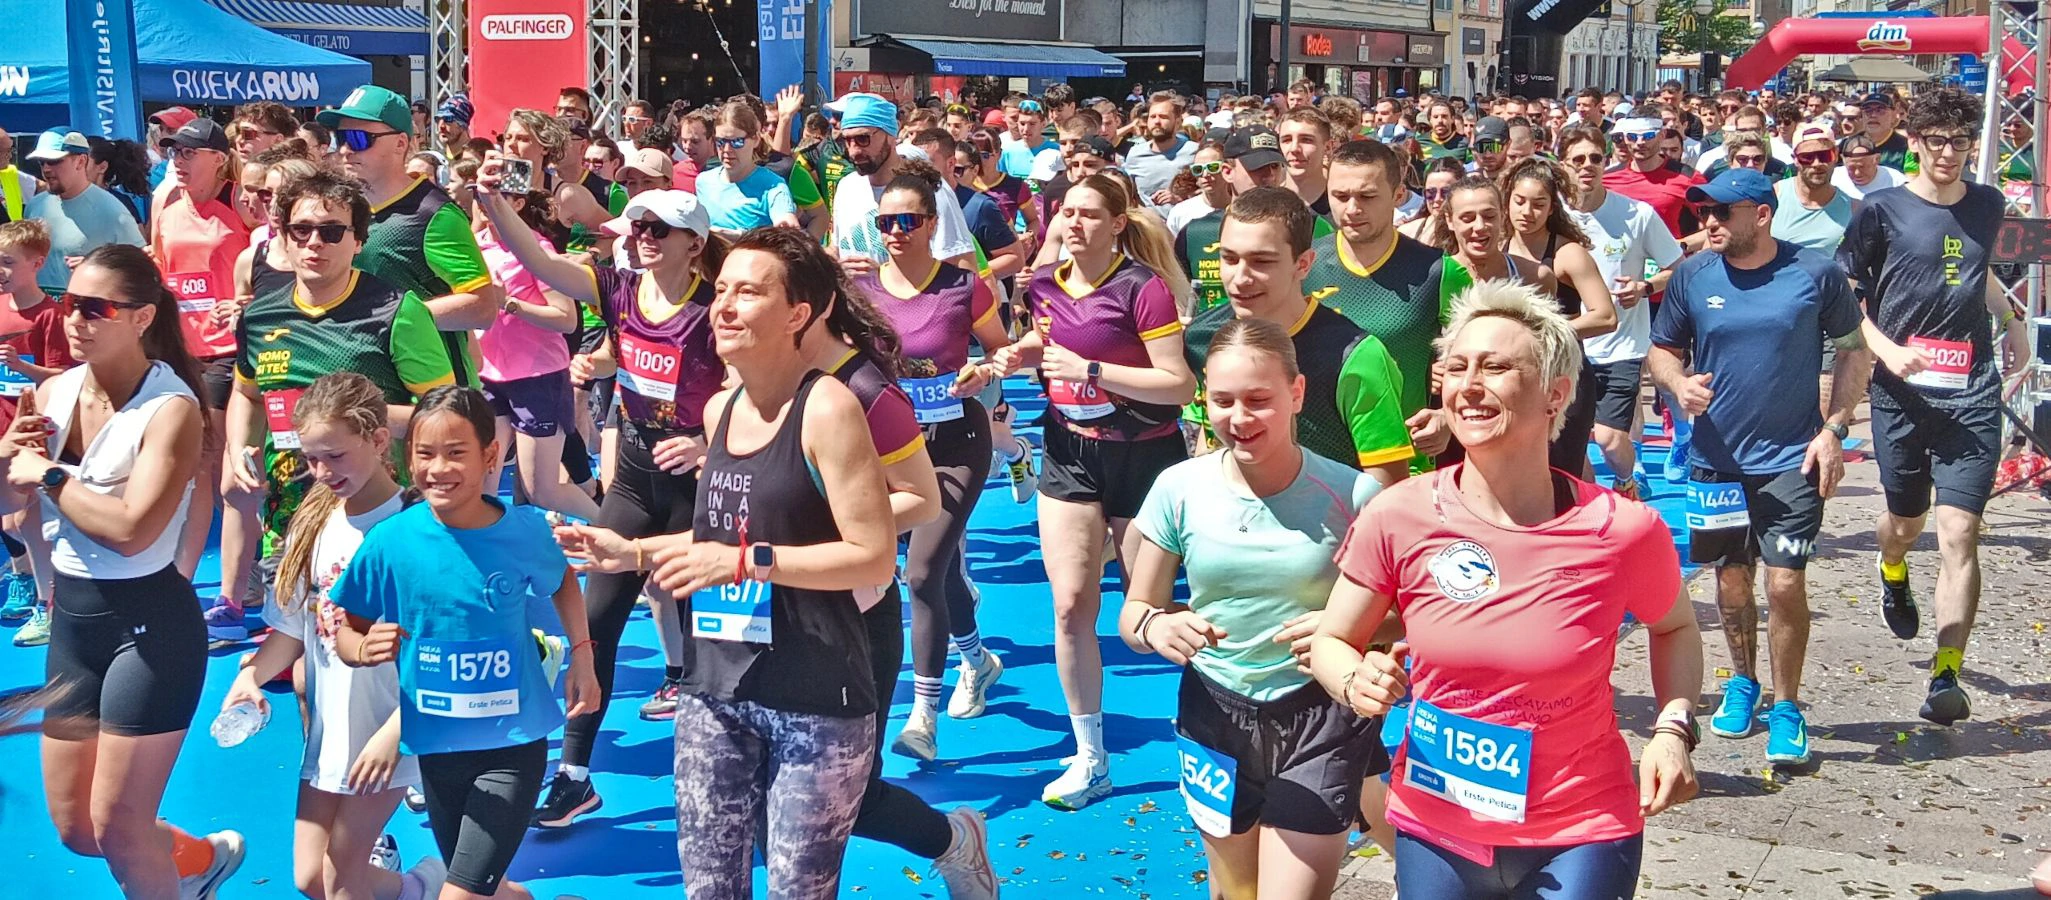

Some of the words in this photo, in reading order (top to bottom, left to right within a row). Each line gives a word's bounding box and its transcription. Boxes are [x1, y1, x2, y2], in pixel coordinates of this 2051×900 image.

[488, 20, 566, 34] PALFINGER
[1868, 22, 1903, 41] dm
[314, 34, 350, 49] GELATO
[172, 69, 319, 100] RIJEKARUN
[849, 74, 863, 91] A1
[1208, 270, 1220, 279] TE
[181, 278, 208, 295] 608
[634, 347, 676, 375] 1009
[917, 381, 956, 403] 133
[710, 471, 752, 493] MADE
[708, 491, 723, 510] IN
[738, 495, 749, 514] A
[1698, 489, 1742, 509] 1442
[447, 649, 511, 682] 1578
[1443, 727, 1521, 778] 1584
[1464, 789, 1485, 803] Erste
[1489, 796, 1518, 811] Petica
